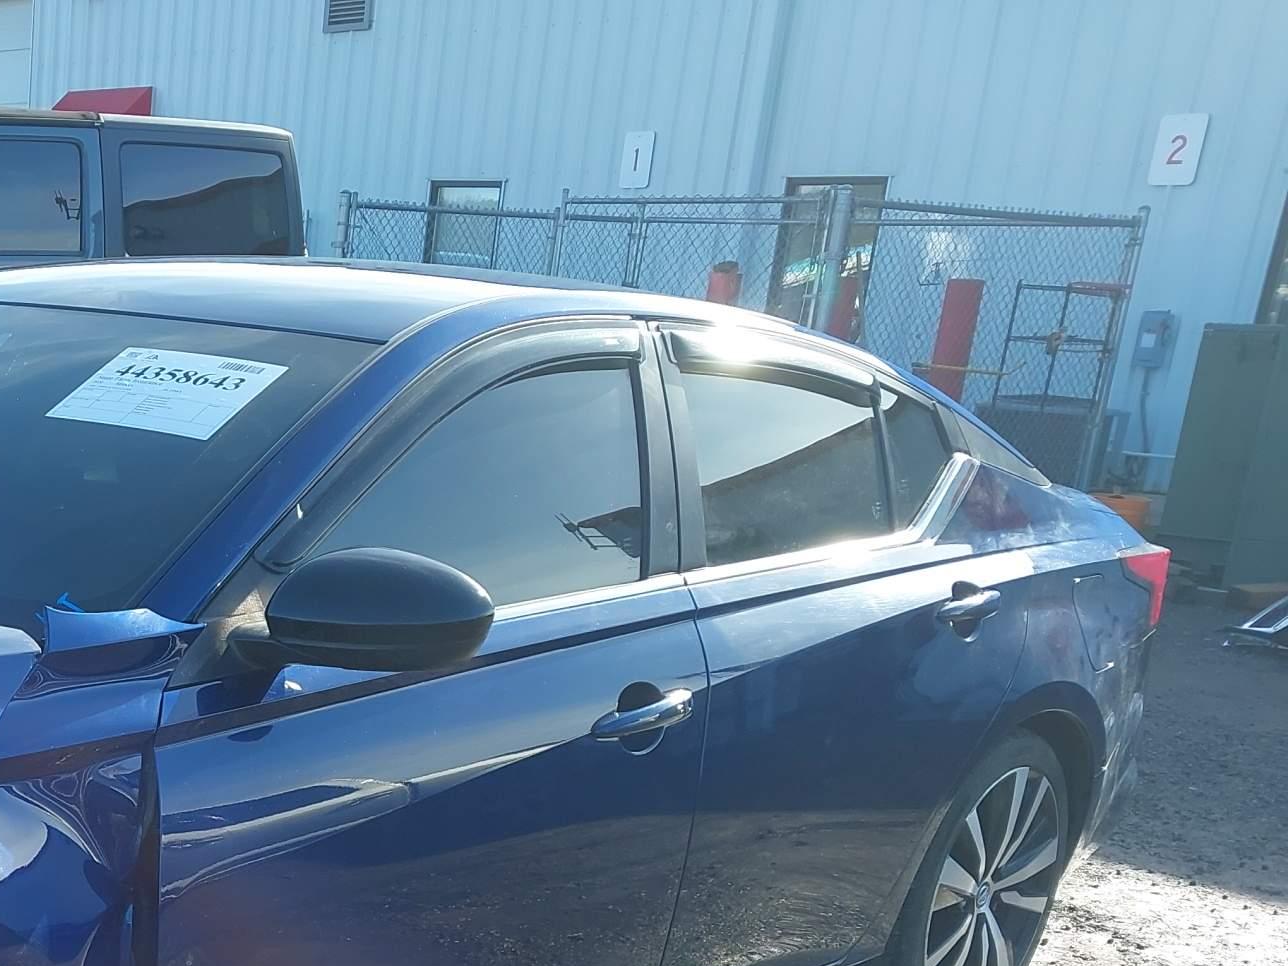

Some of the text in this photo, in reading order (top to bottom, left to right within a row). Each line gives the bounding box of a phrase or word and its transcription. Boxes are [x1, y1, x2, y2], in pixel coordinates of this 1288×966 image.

[633, 147, 640, 172] 1
[1166, 135, 1187, 165] 2
[115, 364, 247, 391] 44358643
